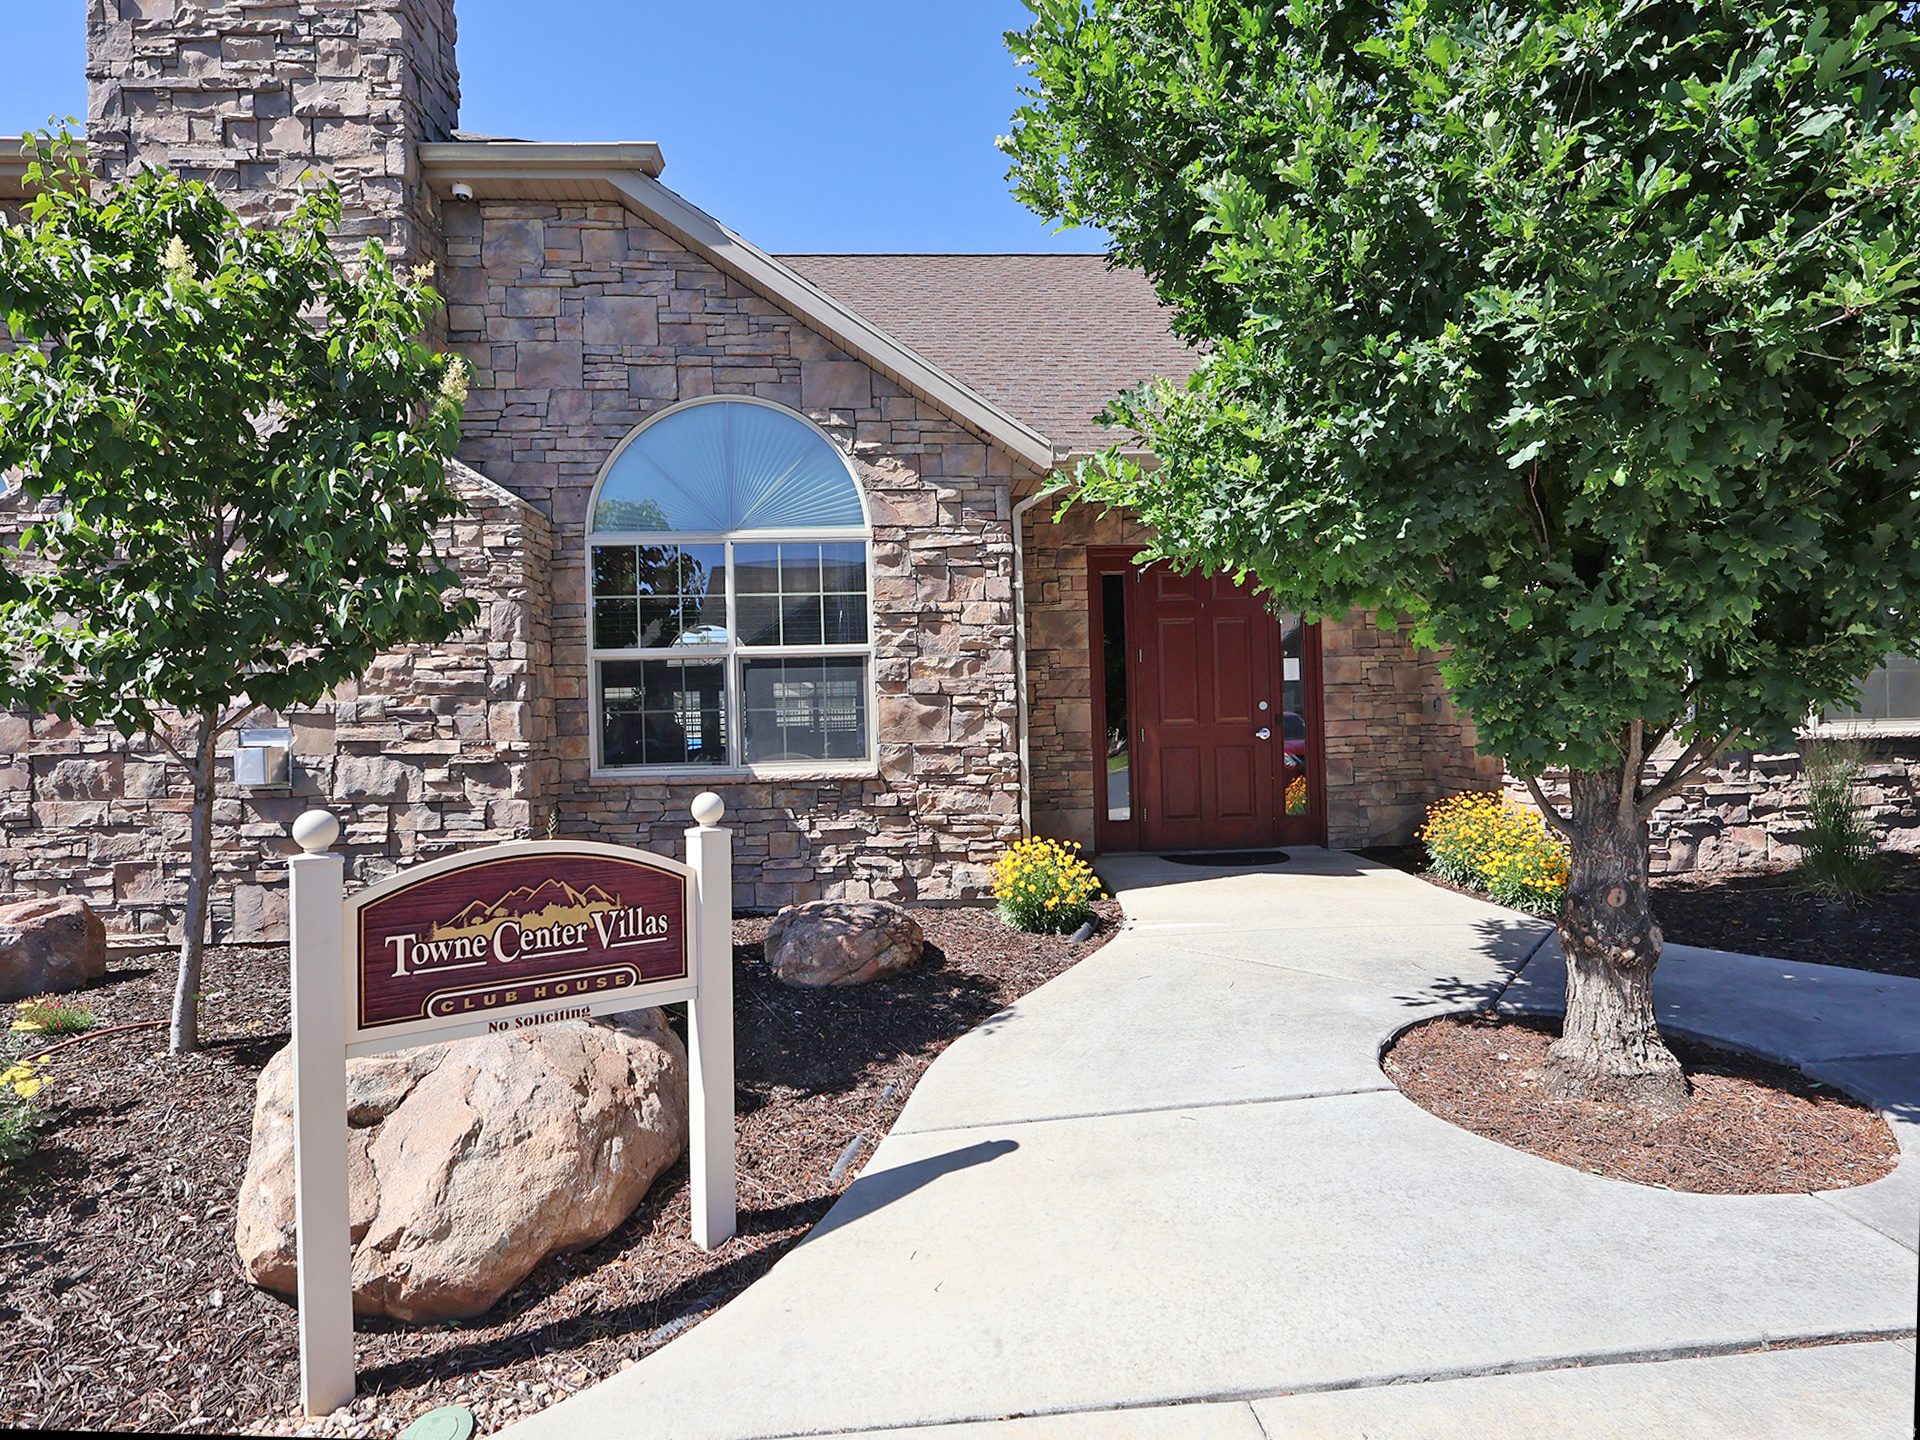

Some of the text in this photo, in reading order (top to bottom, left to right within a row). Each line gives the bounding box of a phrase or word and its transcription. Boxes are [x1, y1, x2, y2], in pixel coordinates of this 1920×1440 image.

[385, 907, 669, 978] Towne Center Villas
[440, 974, 628, 1013] CLUB HOUSE
[487, 1004, 592, 1034] No Soliciting
